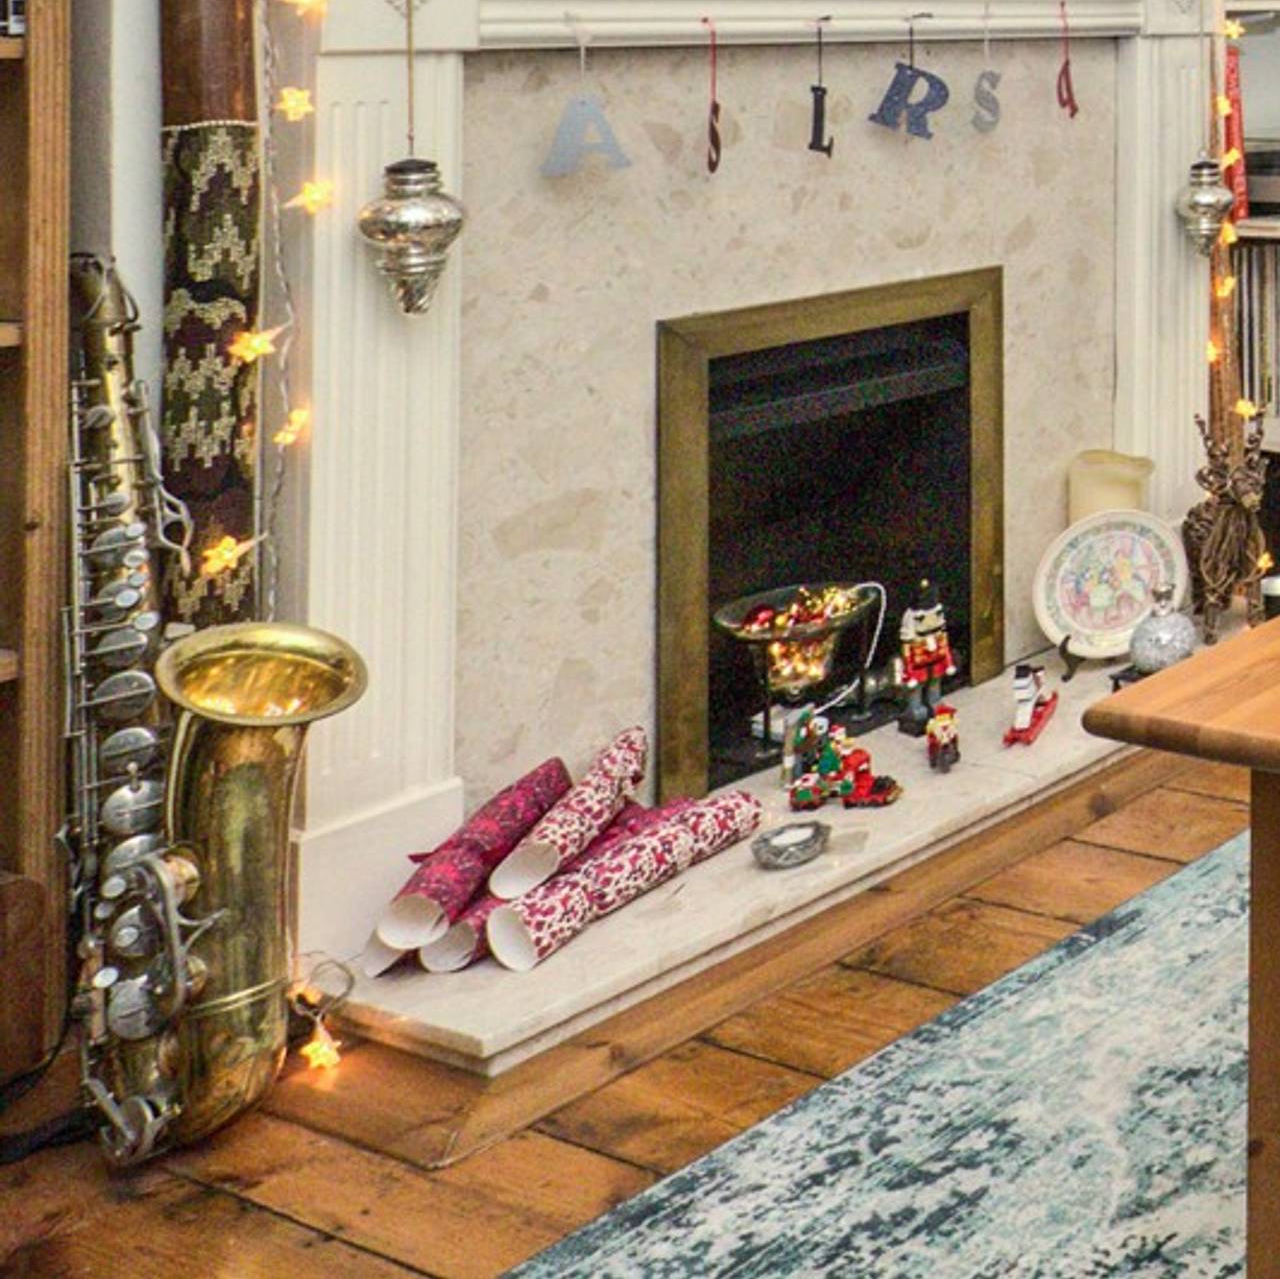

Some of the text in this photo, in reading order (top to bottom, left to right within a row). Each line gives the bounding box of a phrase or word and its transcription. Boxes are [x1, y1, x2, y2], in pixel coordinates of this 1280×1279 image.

[540, 94, 632, 177] A
[868, 61, 950, 140] R
[971, 69, 1002, 134] S
